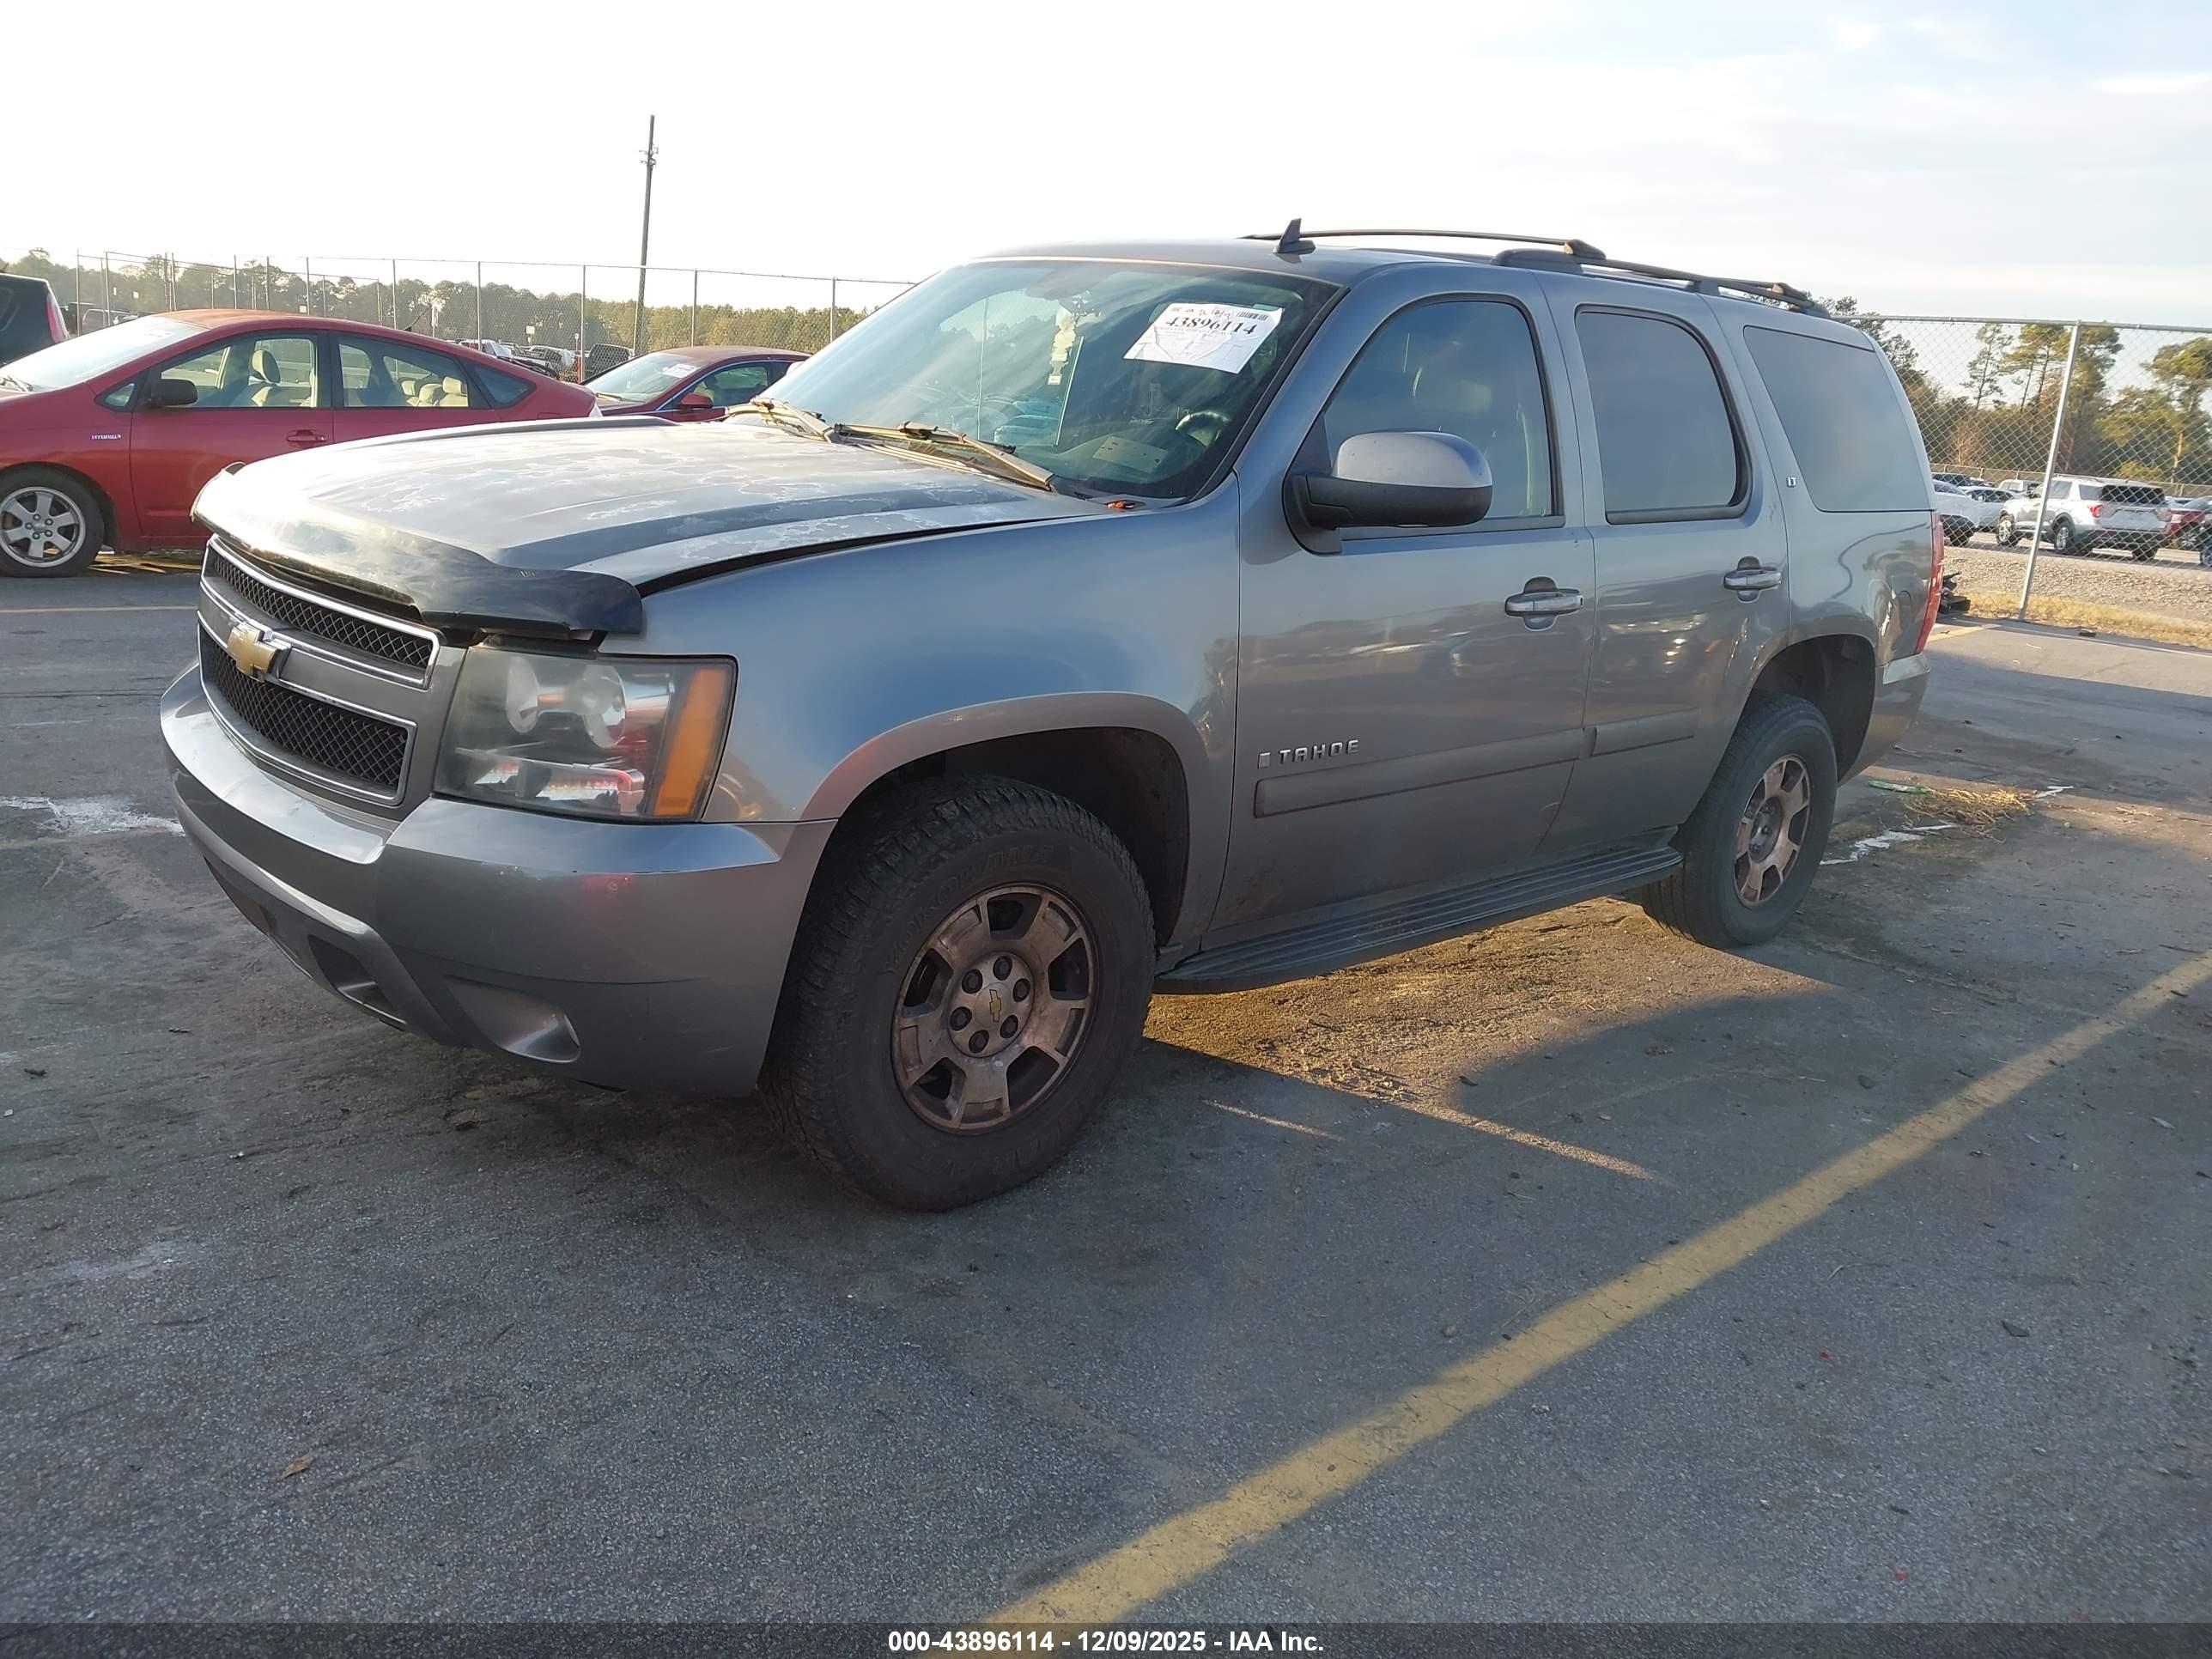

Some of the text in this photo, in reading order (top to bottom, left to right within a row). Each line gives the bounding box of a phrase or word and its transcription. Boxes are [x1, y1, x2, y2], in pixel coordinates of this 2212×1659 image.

[1165, 315, 1259, 334] 43896114
[1786, 477, 1797, 488] LT
[1279, 738, 1360, 764] TAHOE
